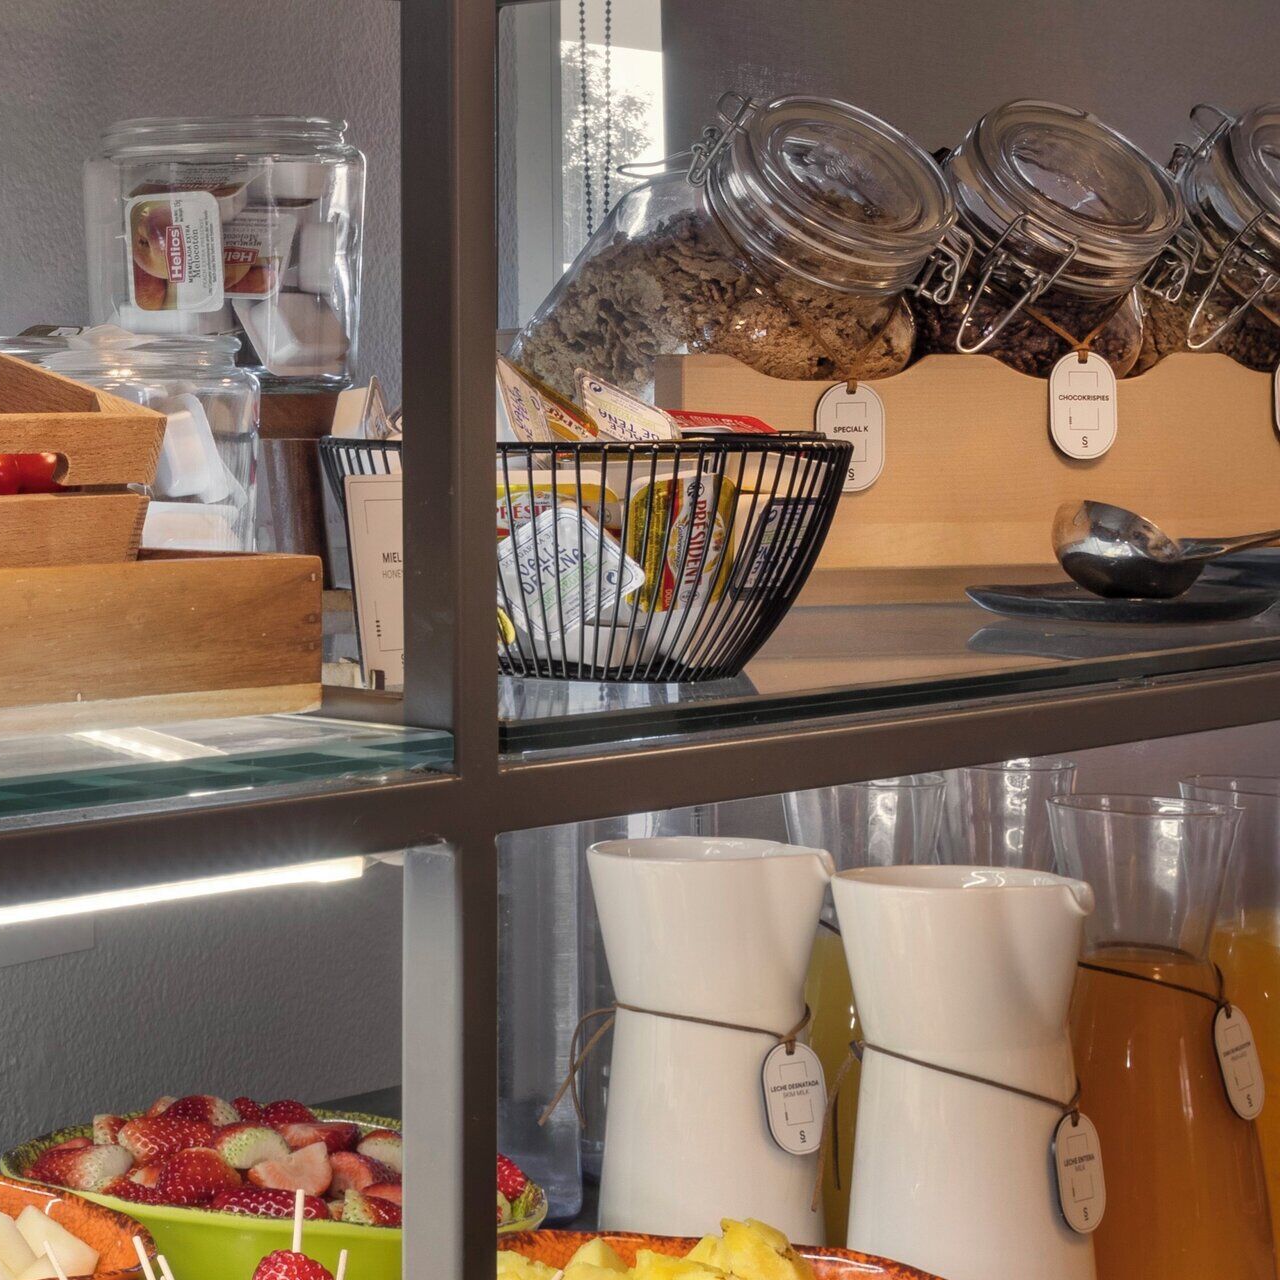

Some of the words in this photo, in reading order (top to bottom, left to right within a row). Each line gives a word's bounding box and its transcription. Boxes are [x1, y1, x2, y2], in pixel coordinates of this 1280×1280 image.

[169, 228, 182, 279] Helios
[191, 228, 201, 279] Melocotón
[224, 251, 253, 262] Heli
[186, 245, 194, 284] MERMELADA
[1058, 394, 1110, 402] CHOCOKRISPIES
[382, 552, 402, 563] MIEL
[382, 569, 403, 579] HONE
[770, 1085, 787, 1093] LECHE
